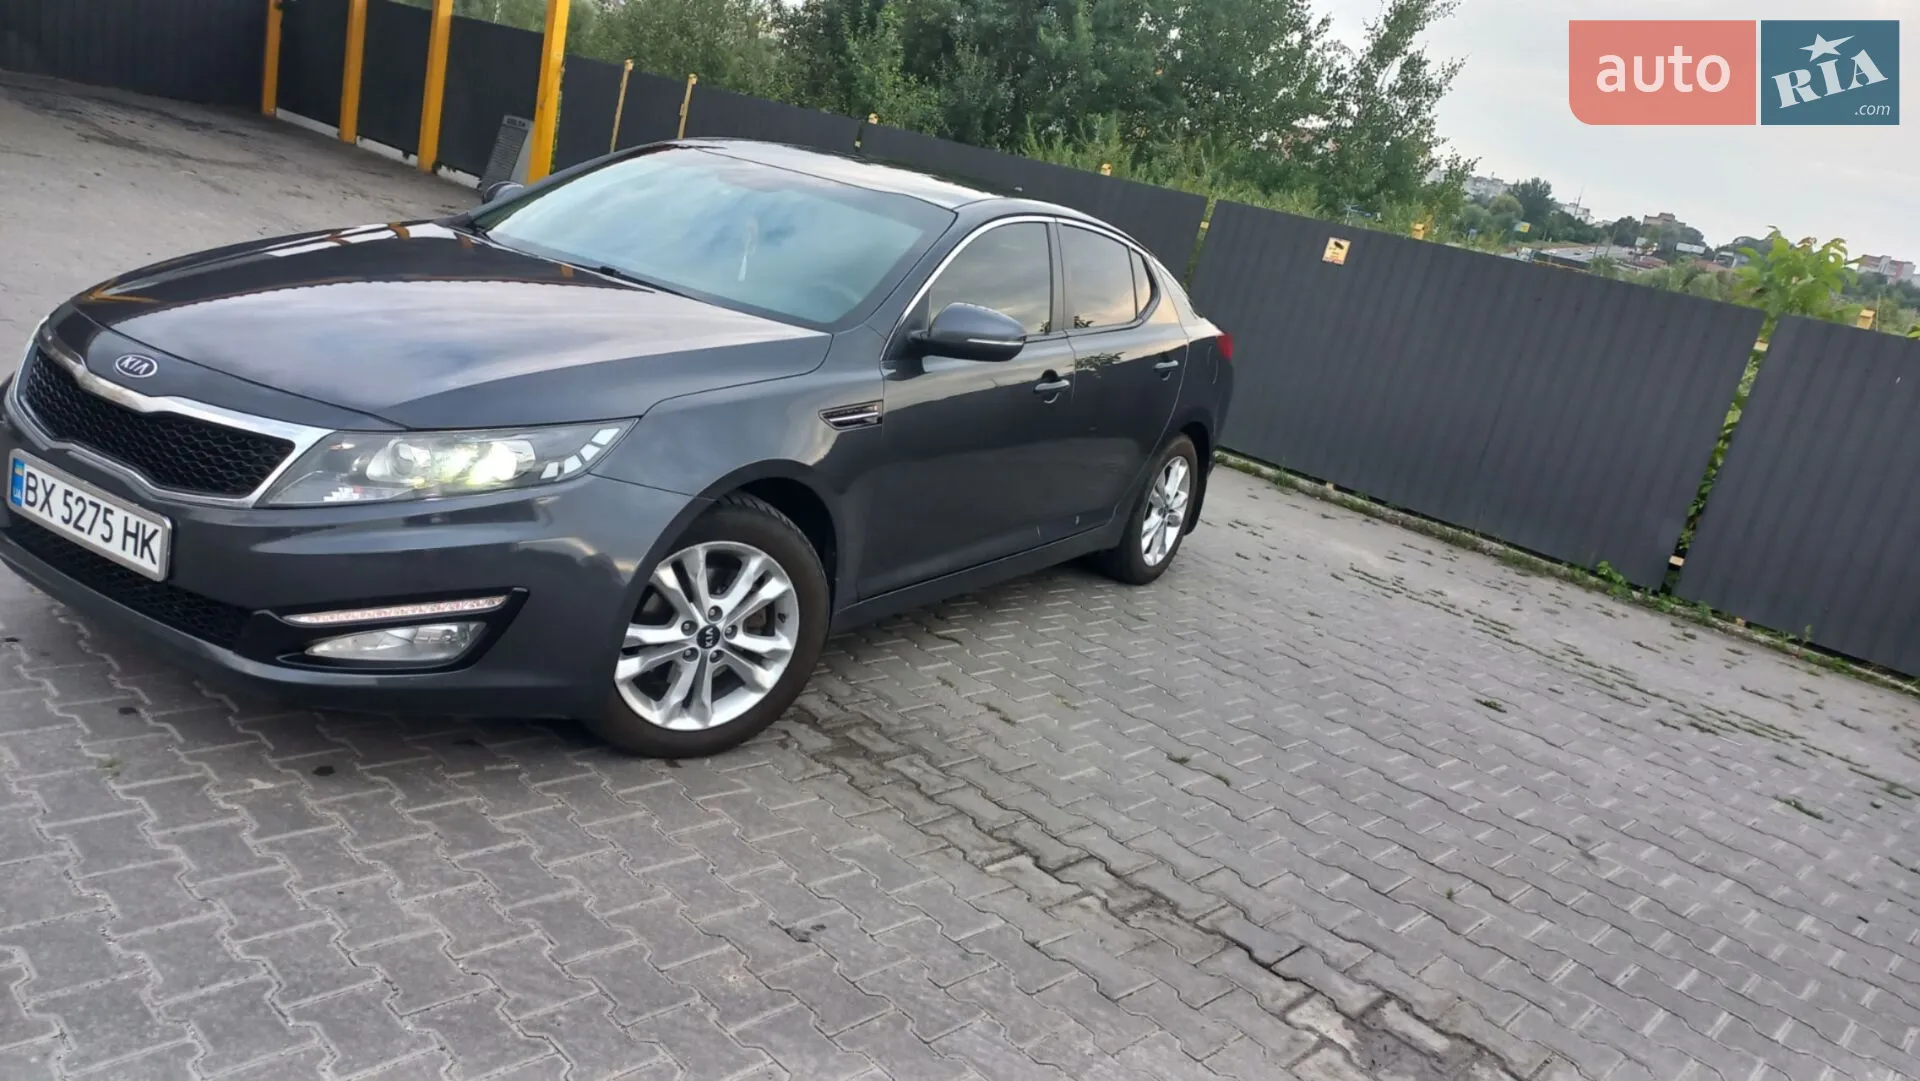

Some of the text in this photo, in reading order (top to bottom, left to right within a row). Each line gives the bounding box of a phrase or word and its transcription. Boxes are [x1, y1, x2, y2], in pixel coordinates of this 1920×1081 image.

[120, 356, 150, 375] KIA
[24, 470, 160, 565] BX 5275 HK
